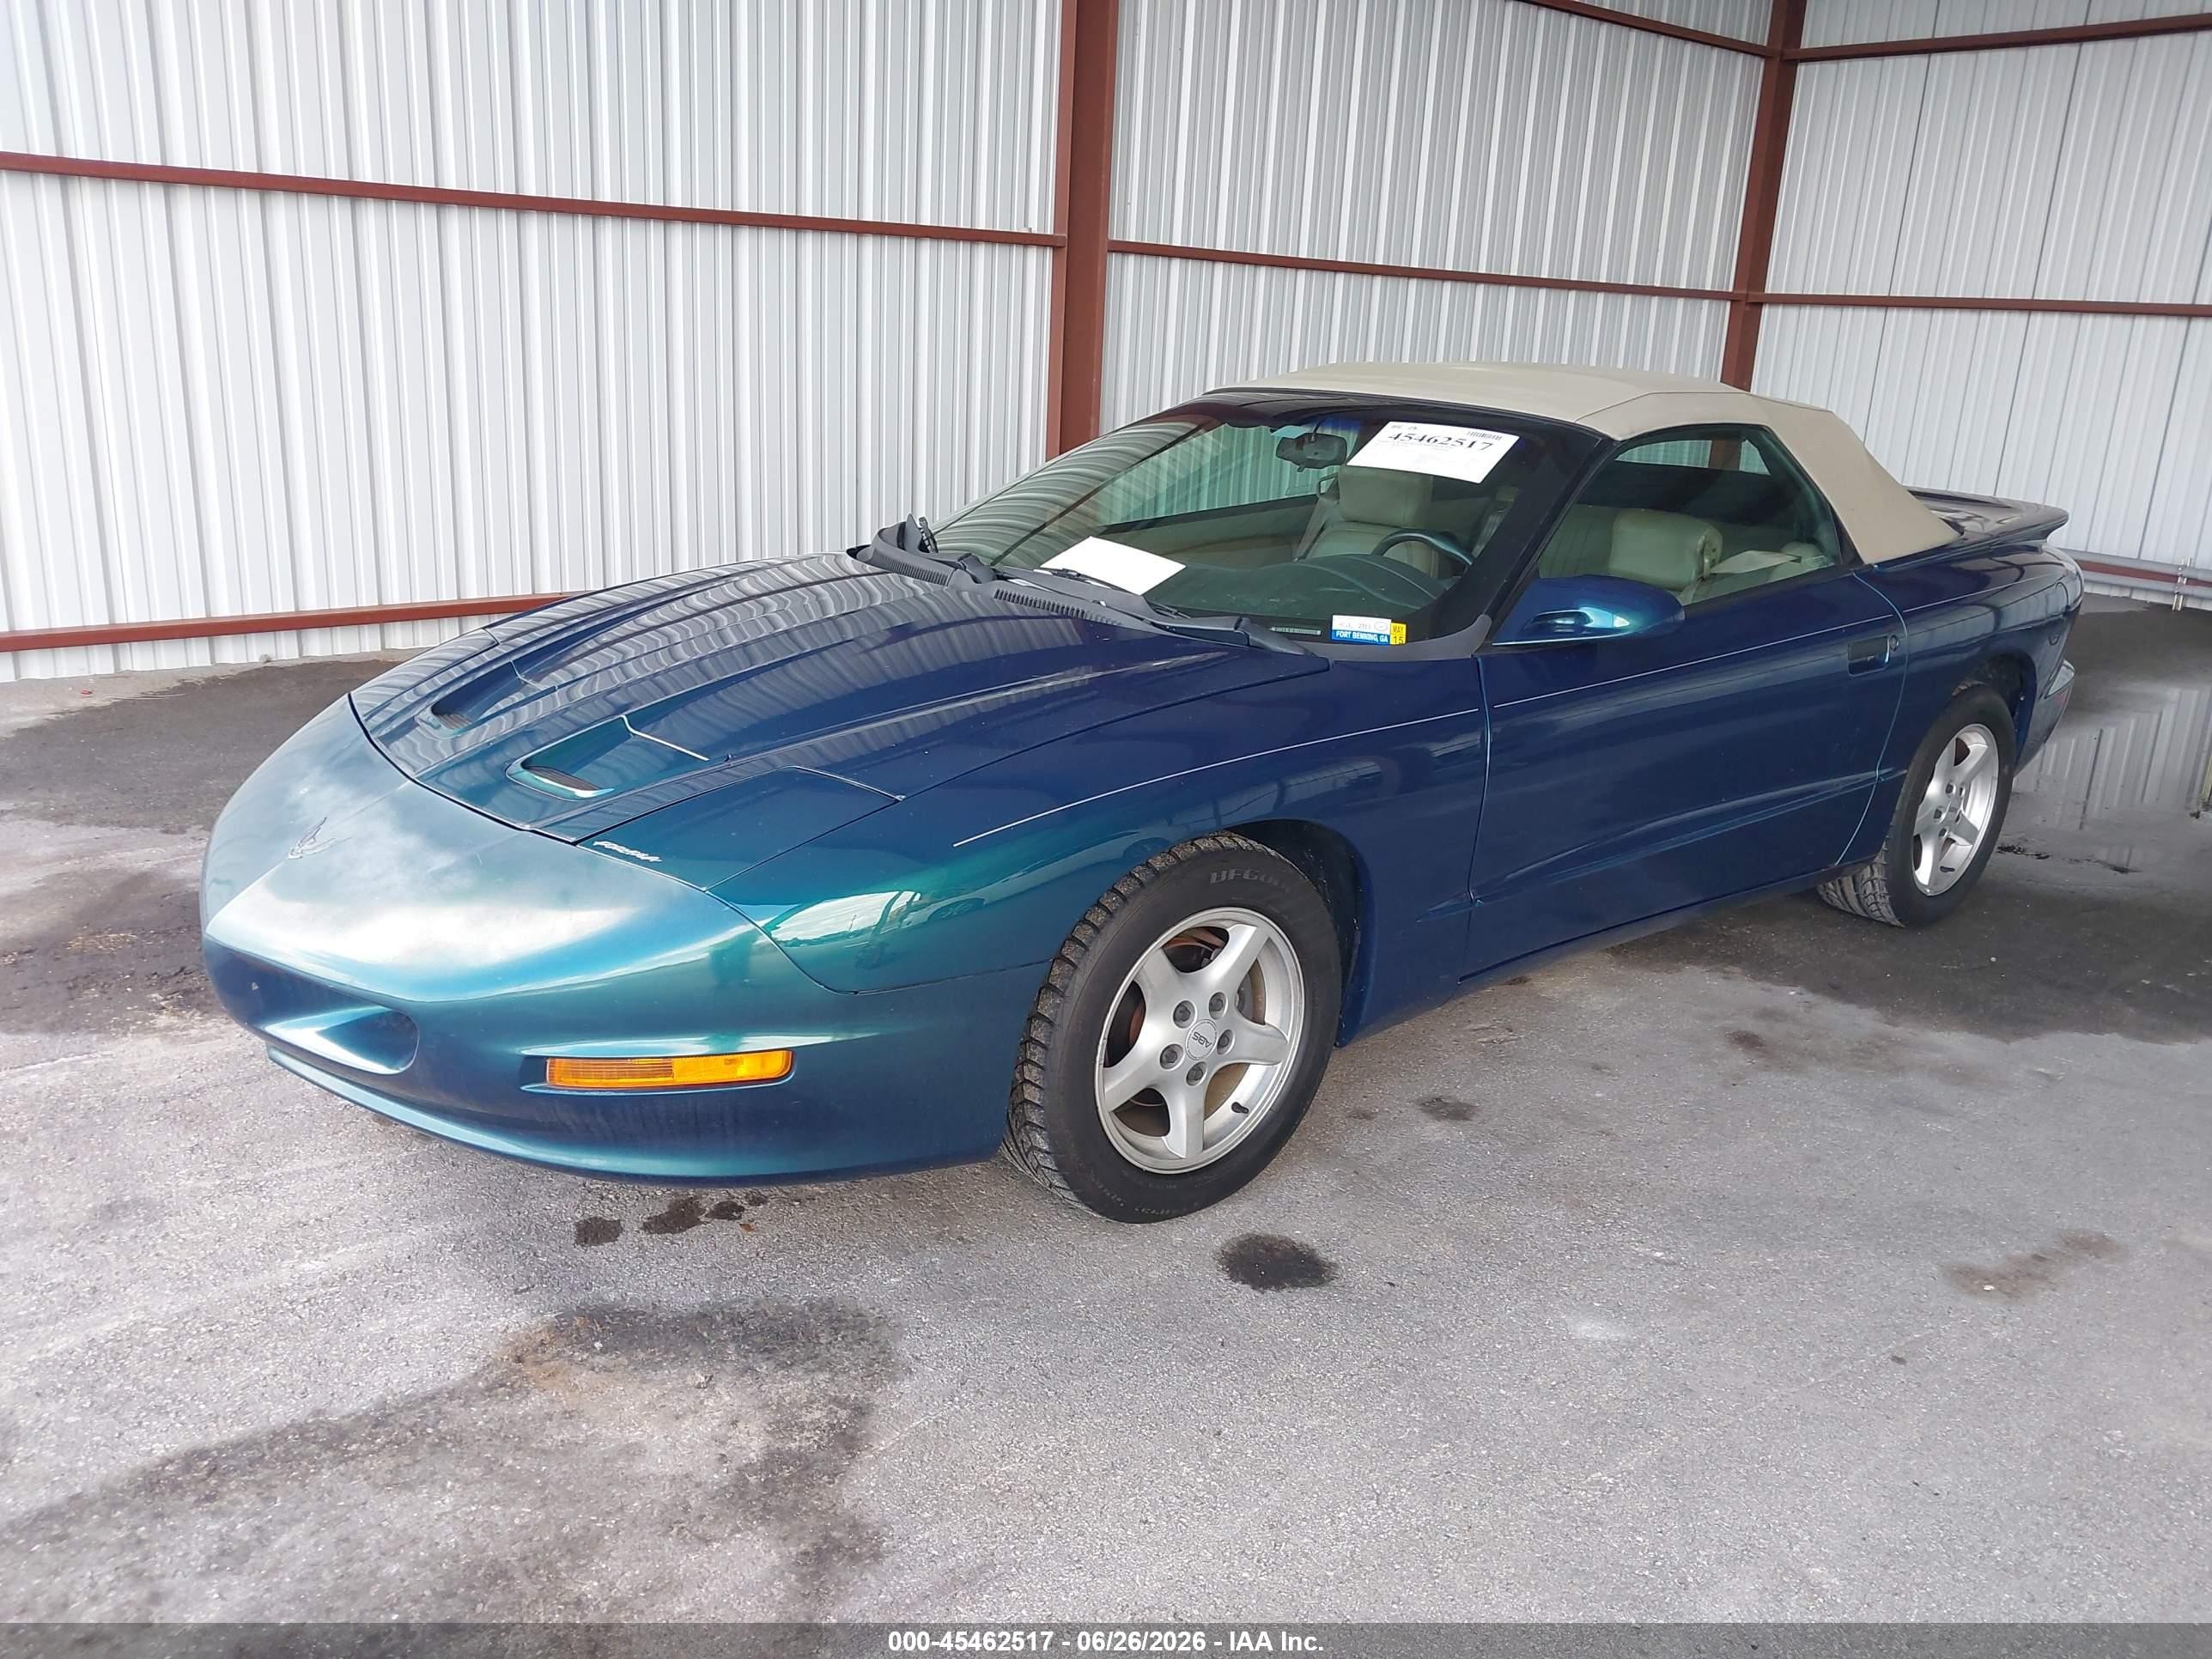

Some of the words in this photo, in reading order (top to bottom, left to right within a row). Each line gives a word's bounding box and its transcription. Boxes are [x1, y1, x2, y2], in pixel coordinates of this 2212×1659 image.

[1388, 432, 1494, 452] 45462517
[1335, 630, 1352, 639] FORT
[1379, 635, 1389, 643] GA
[1192, 1031, 1212, 1048] ABS
